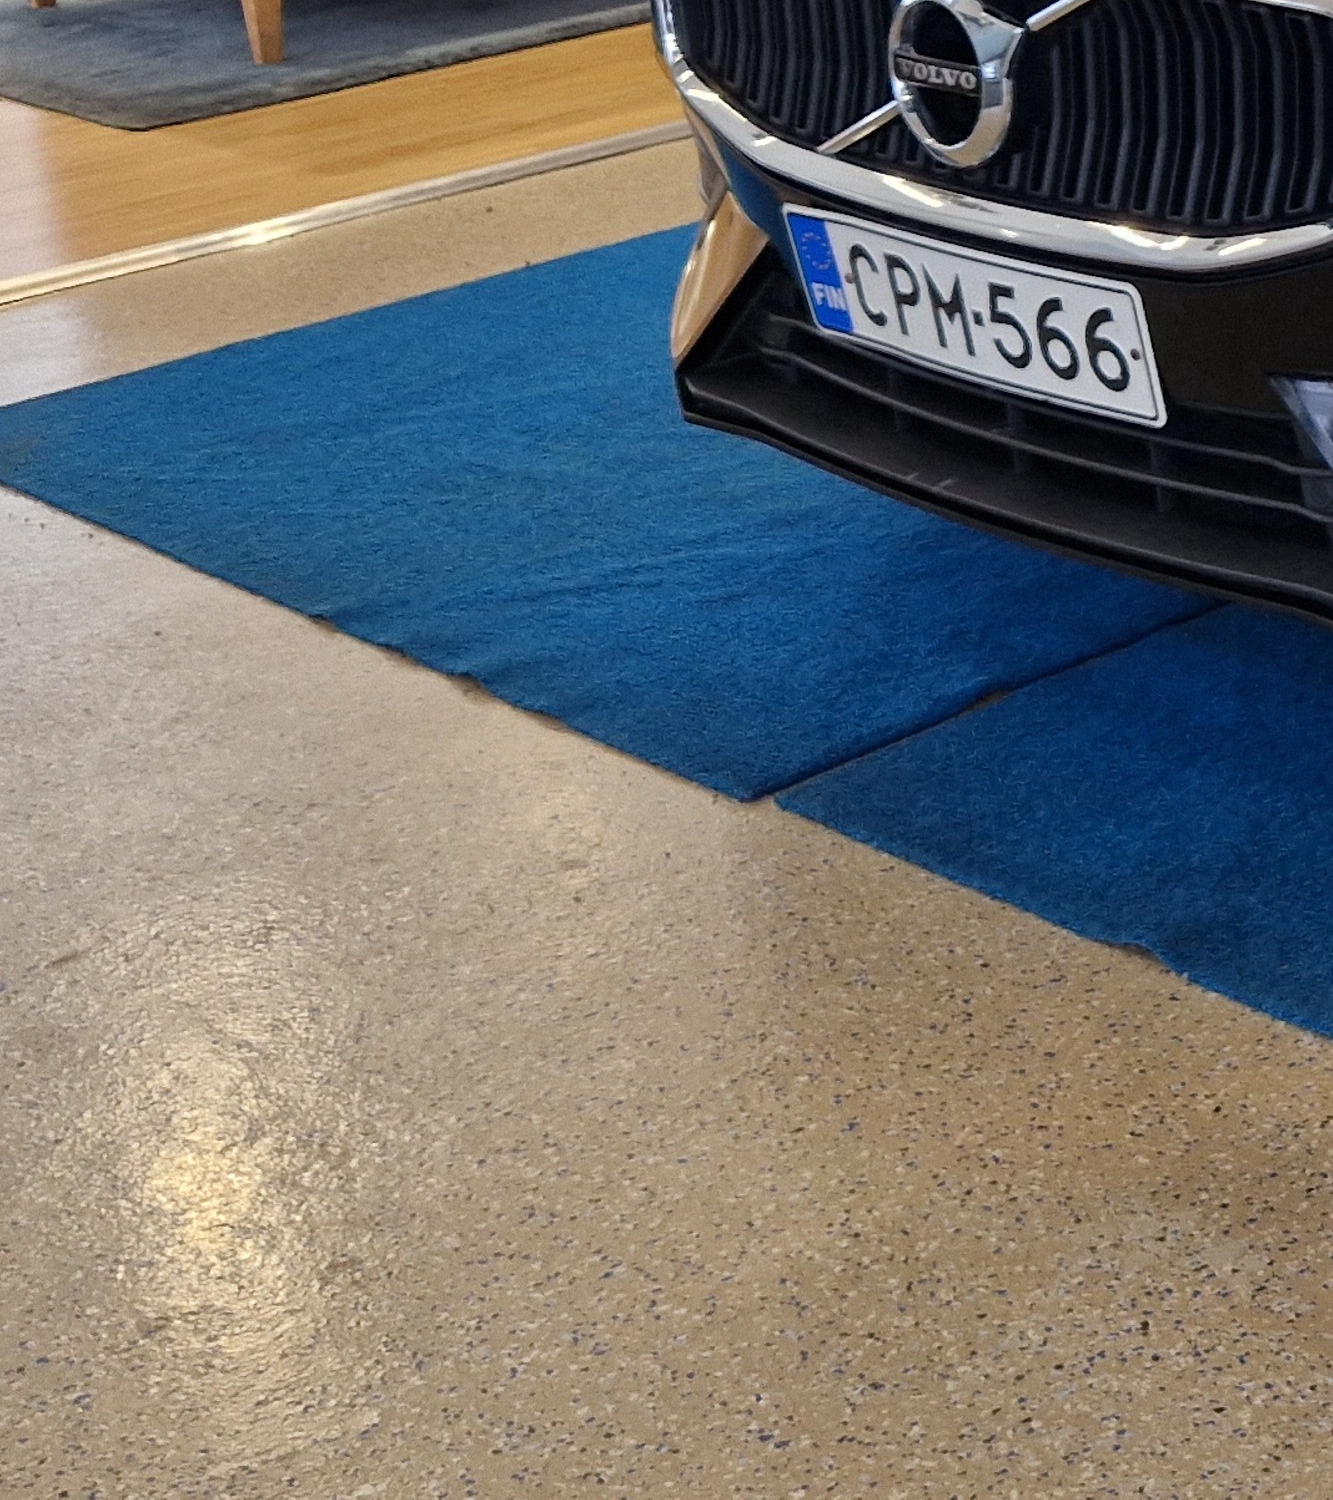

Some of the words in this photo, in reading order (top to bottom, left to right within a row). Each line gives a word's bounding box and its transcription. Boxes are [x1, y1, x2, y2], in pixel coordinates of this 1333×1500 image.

[896, 57, 978, 90] VOLVO
[809, 281, 848, 311] FIN
[848, 243, 1131, 393] CPM-566
